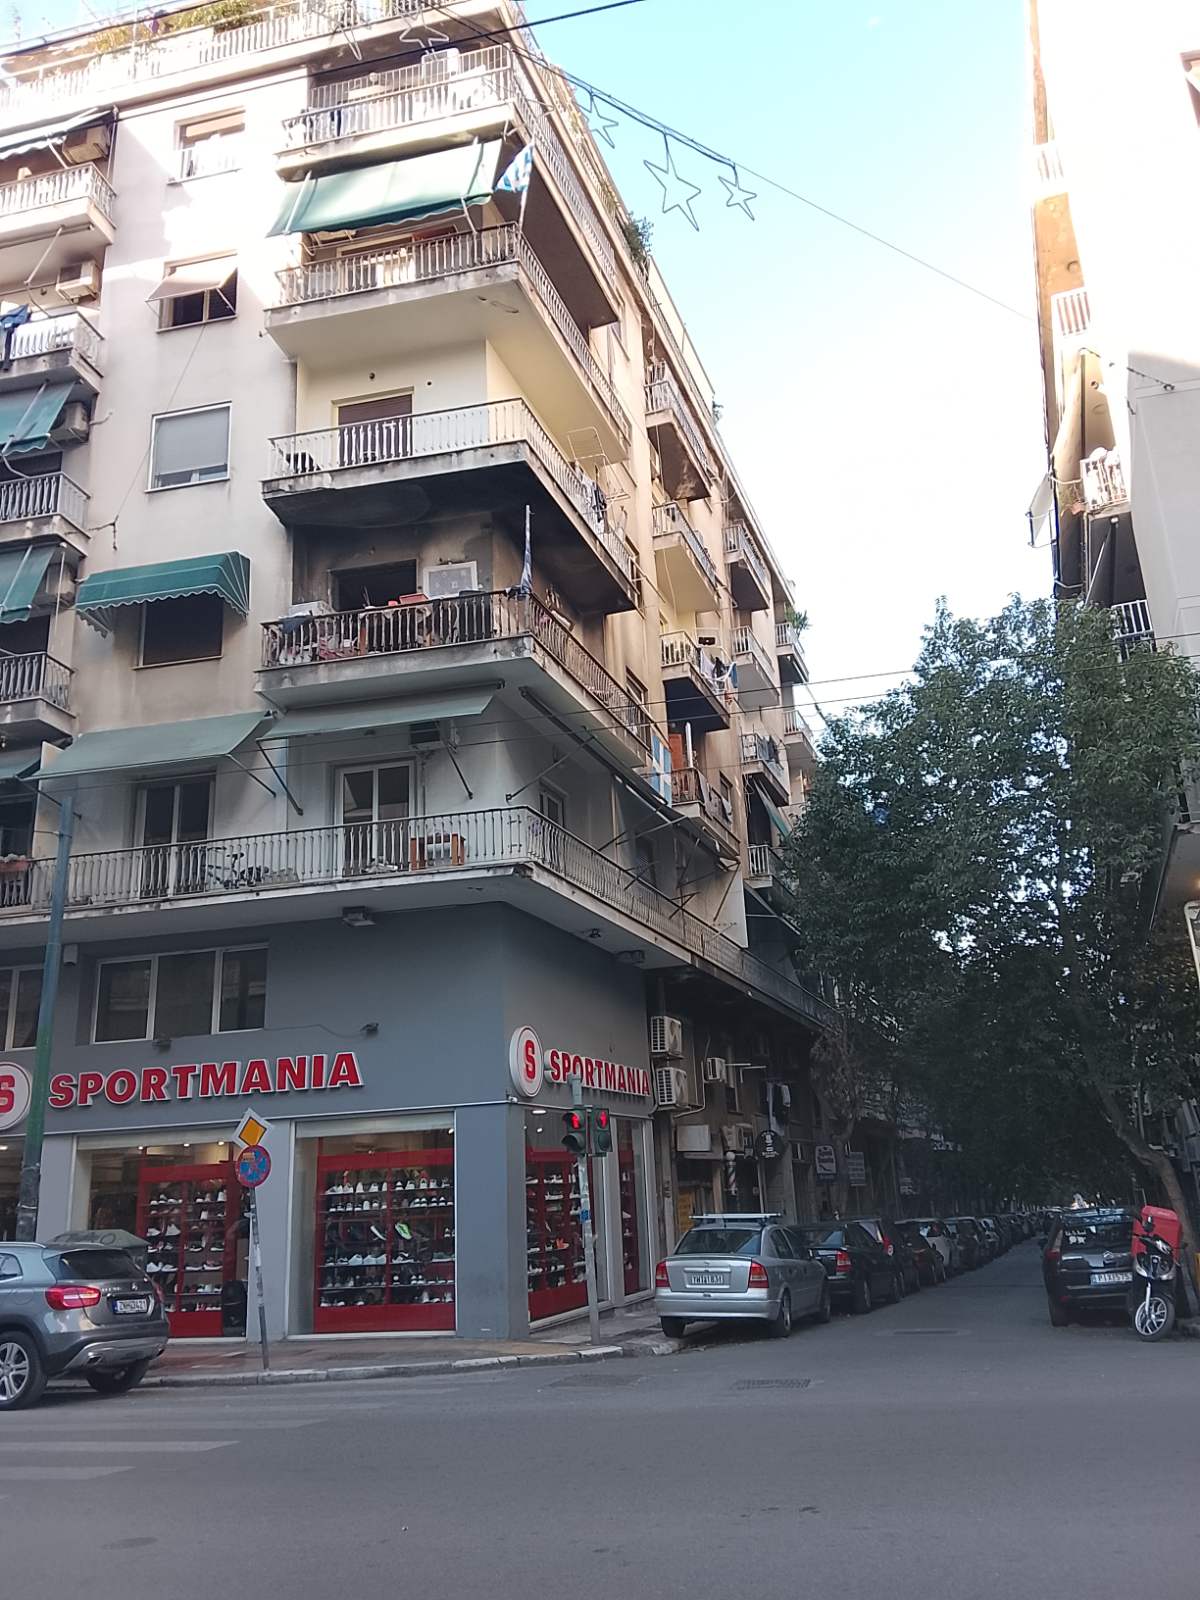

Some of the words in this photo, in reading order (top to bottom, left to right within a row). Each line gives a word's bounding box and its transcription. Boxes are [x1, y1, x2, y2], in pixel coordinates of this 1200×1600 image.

[48, 1051, 365, 1109] SPORTMANIA
[524, 1039, 536, 1080] S
[547, 1049, 651, 1097] SPORTMANIA
